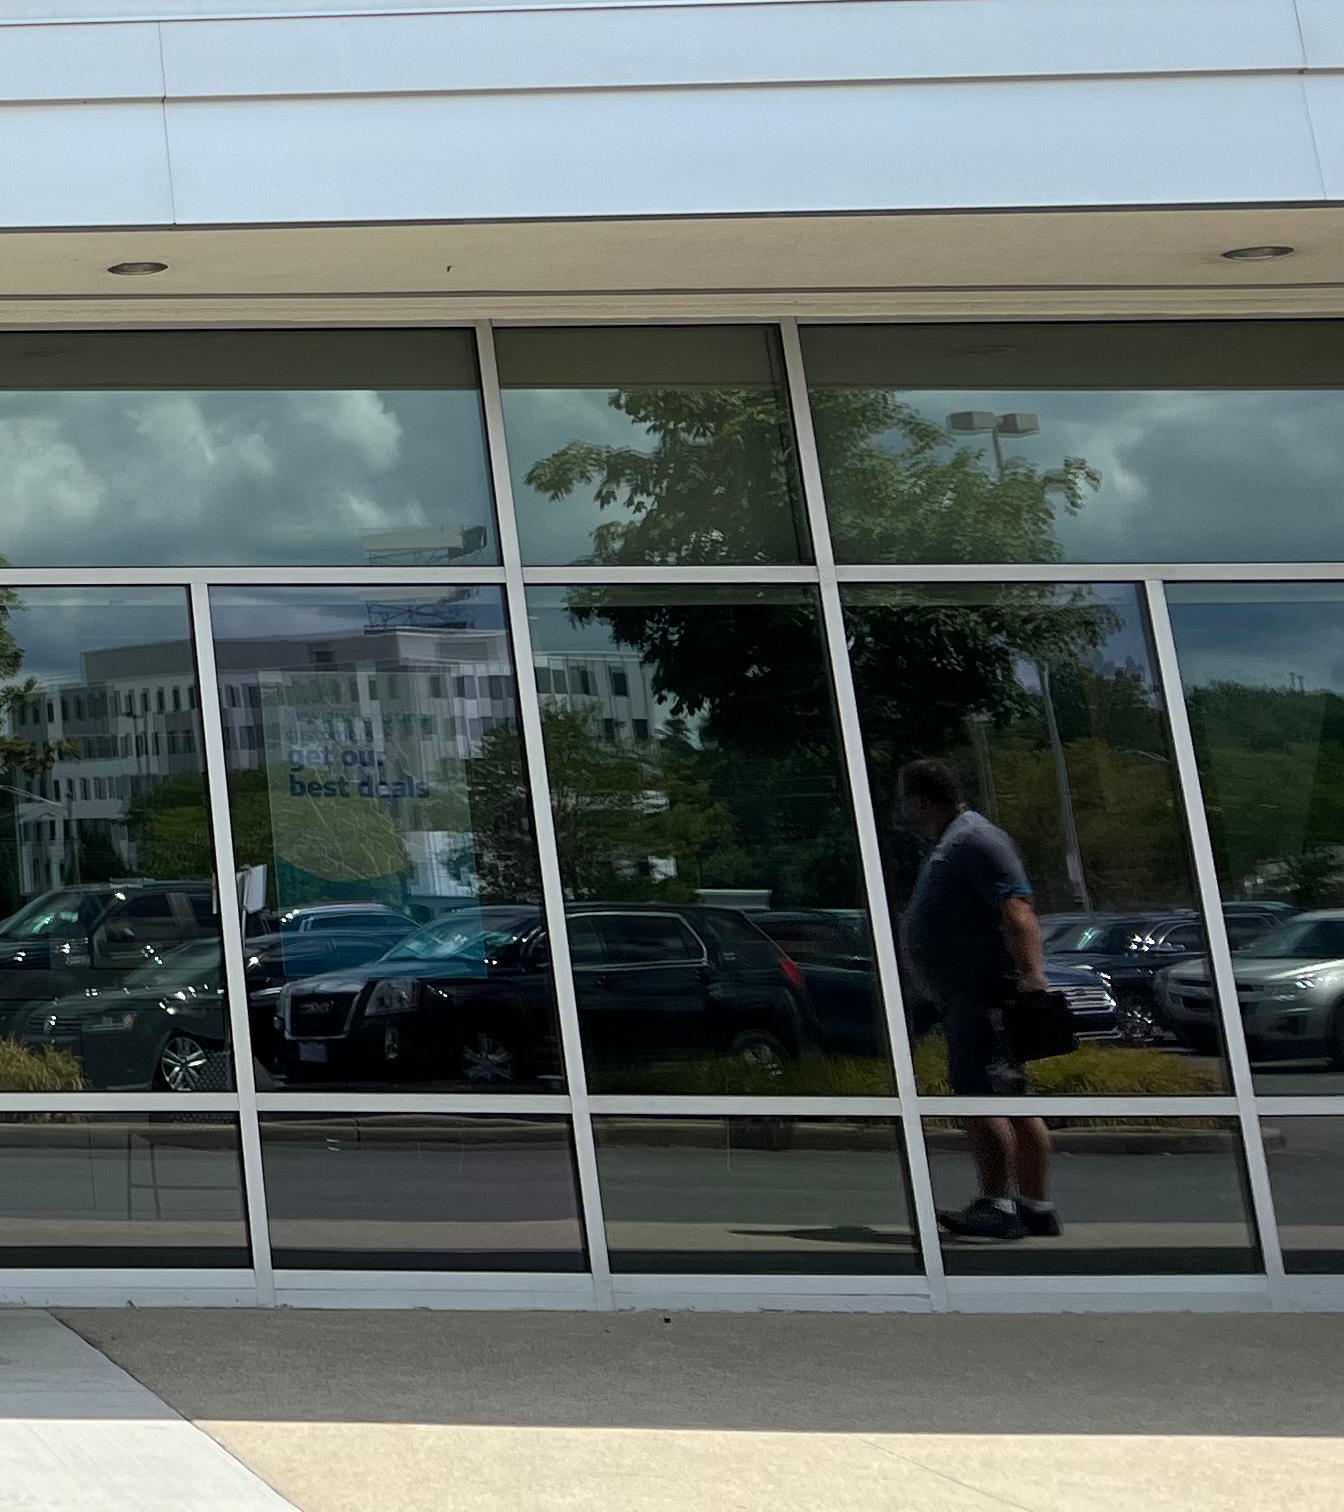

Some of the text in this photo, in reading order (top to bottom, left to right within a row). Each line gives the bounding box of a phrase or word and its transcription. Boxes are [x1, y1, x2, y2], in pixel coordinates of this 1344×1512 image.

[288, 746, 333, 772] get
[289, 774, 430, 798] best deals
